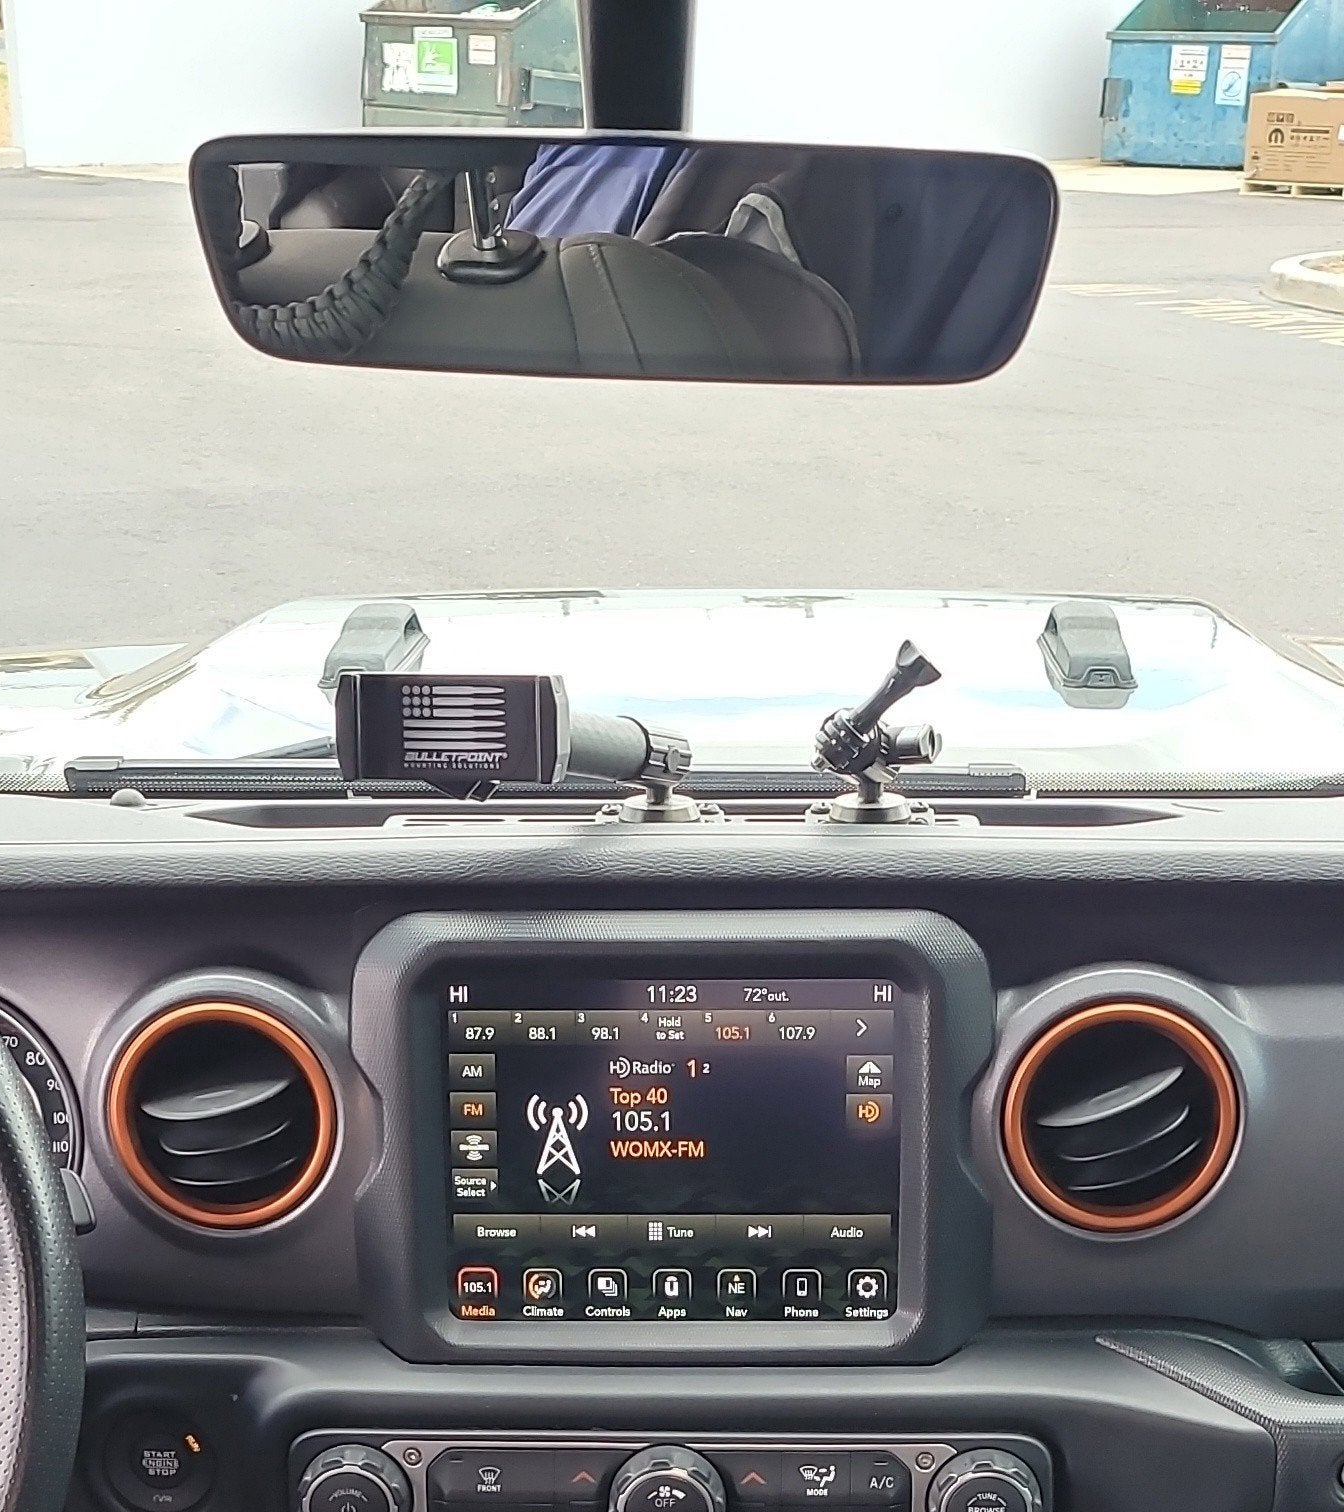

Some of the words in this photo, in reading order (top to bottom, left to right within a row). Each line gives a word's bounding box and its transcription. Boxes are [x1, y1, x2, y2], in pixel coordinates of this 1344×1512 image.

[449, 986, 468, 1003] HI
[647, 985, 698, 1003] 11:23
[873, 985, 893, 1003] HI
[514, 1013, 523, 1024] 2
[577, 1013, 586, 1024] 3
[640, 1013, 649, 1024] 4
[658, 1017, 682, 1028] Hold
[704, 1013, 713, 1023] 5
[768, 1013, 776, 1023] 6
[465, 1027, 495, 1041] 87.9
[528, 1027, 557, 1041] 88.1
[591, 1027, 620, 1041] 98.1
[656, 1032, 666, 1040] to
[668, 1031, 685, 1040] Set
[715, 1027, 751, 1040] 105.1
[778, 1027, 816, 1041] 107.9
[26, 1052, 45, 1065] 80
[462, 1066, 483, 1078] AM
[686, 1060, 697, 1078] 1
[702, 1064, 711, 1073] 2
[858, 1077, 881, 1089] Map
[609, 1088, 642, 1107] Top
[646, 1088, 668, 1104] 40
[464, 1105, 483, 1117] FM
[612, 1111, 671, 1131] 105.1
[610, 1140, 705, 1158] WOMX-FM
[454, 1176, 487, 1186] Source
[456, 1187, 486, 1197] Select
[477, 1226, 517, 1238] Browse
[667, 1227, 694, 1238] Tune
[830, 1227, 864, 1239] Audio
[463, 1281, 492, 1293] 105.1
[728, 1282, 746, 1294] NE
[461, 1306, 496, 1317] Media
[522, 1306, 564, 1317] Climate
[585, 1306, 631, 1317] Controls
[658, 1306, 686, 1319] Apps
[725, 1307, 748, 1317] Nav
[784, 1306, 819, 1317] Phone
[845, 1306, 889, 1319] Settings
[142, 1459, 179, 1468] ENGINE
[477, 1484, 501, 1492] FRONT
[870, 1477, 894, 1489] A/C
[806, 1488, 828, 1496] MODE
[977, 1493, 998, 1501] TUNE
[655, 1498, 676, 1507] OFF
